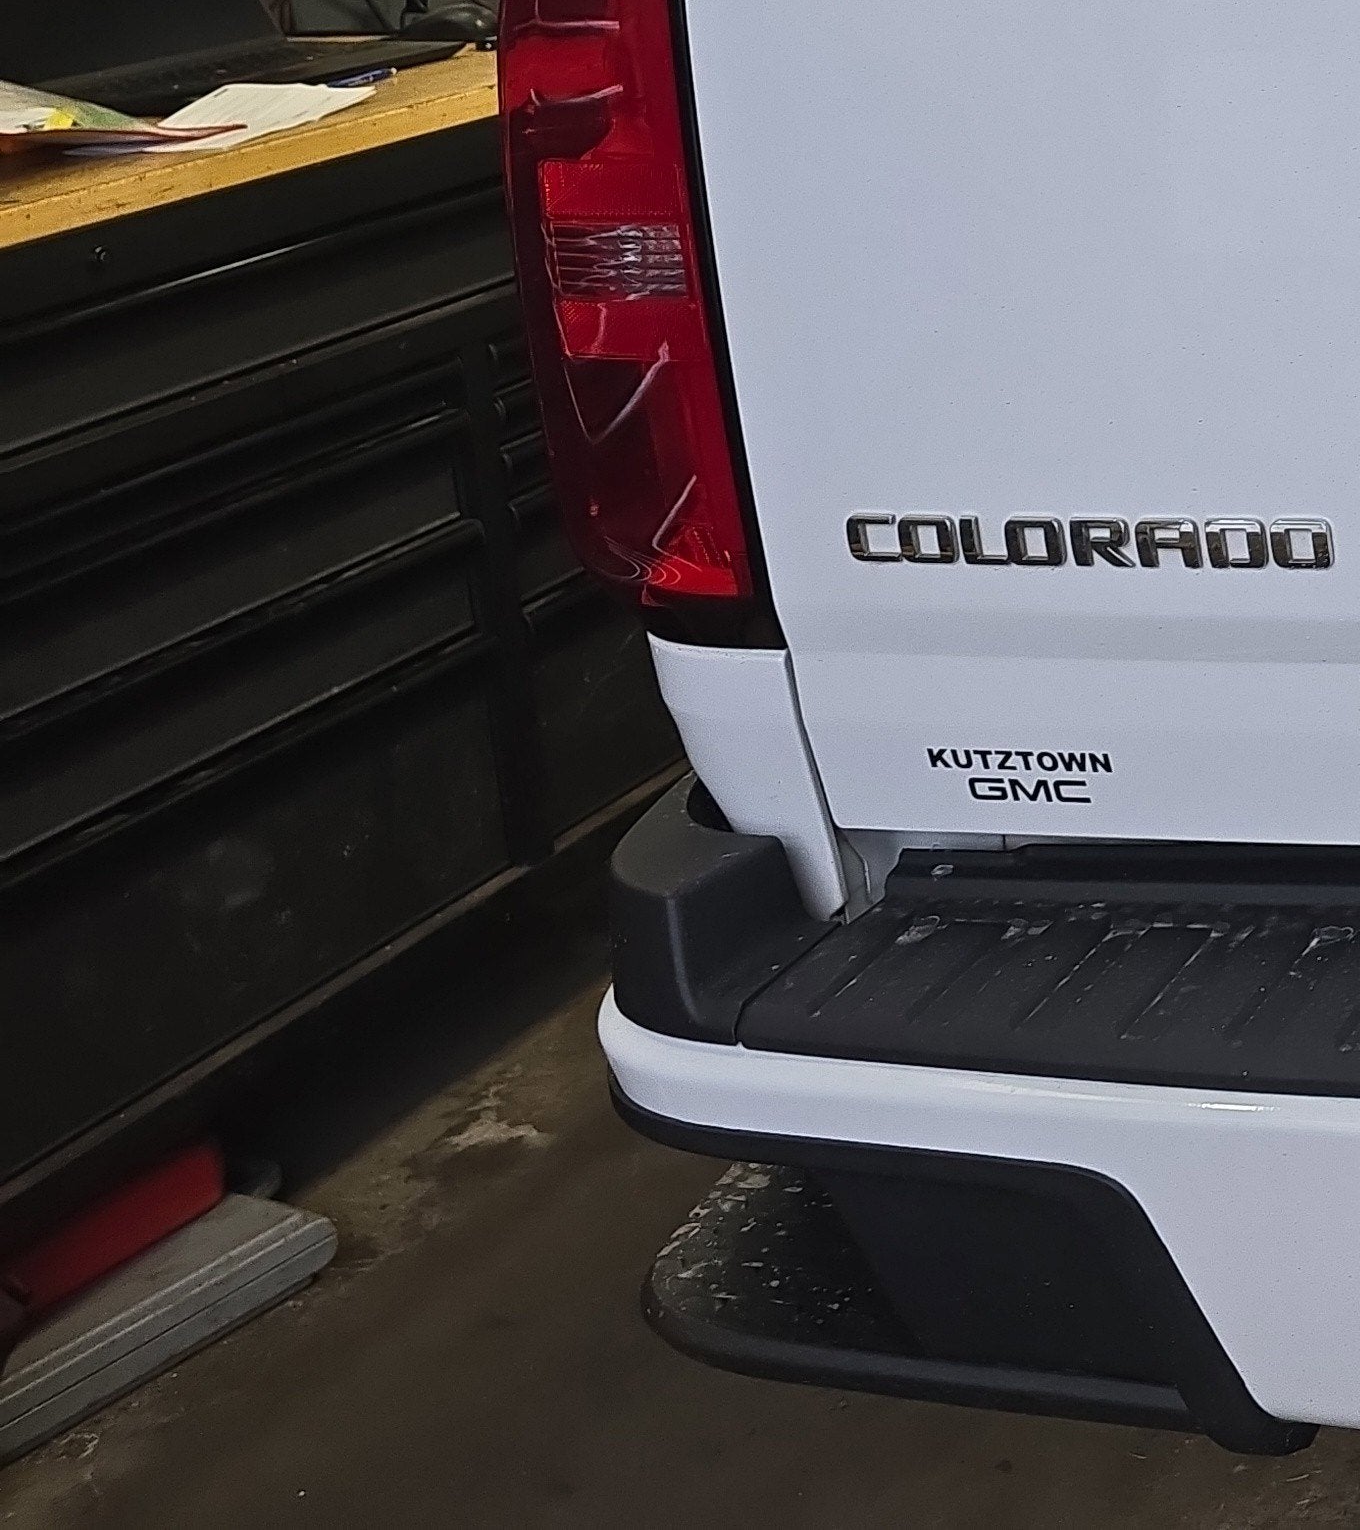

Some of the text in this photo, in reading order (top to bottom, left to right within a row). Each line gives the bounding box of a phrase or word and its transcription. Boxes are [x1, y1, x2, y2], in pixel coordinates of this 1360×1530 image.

[846, 512, 1335, 570] COLORADO
[927, 747, 1114, 773] KUTZTOWN
[968, 777, 1092, 804] GMC
